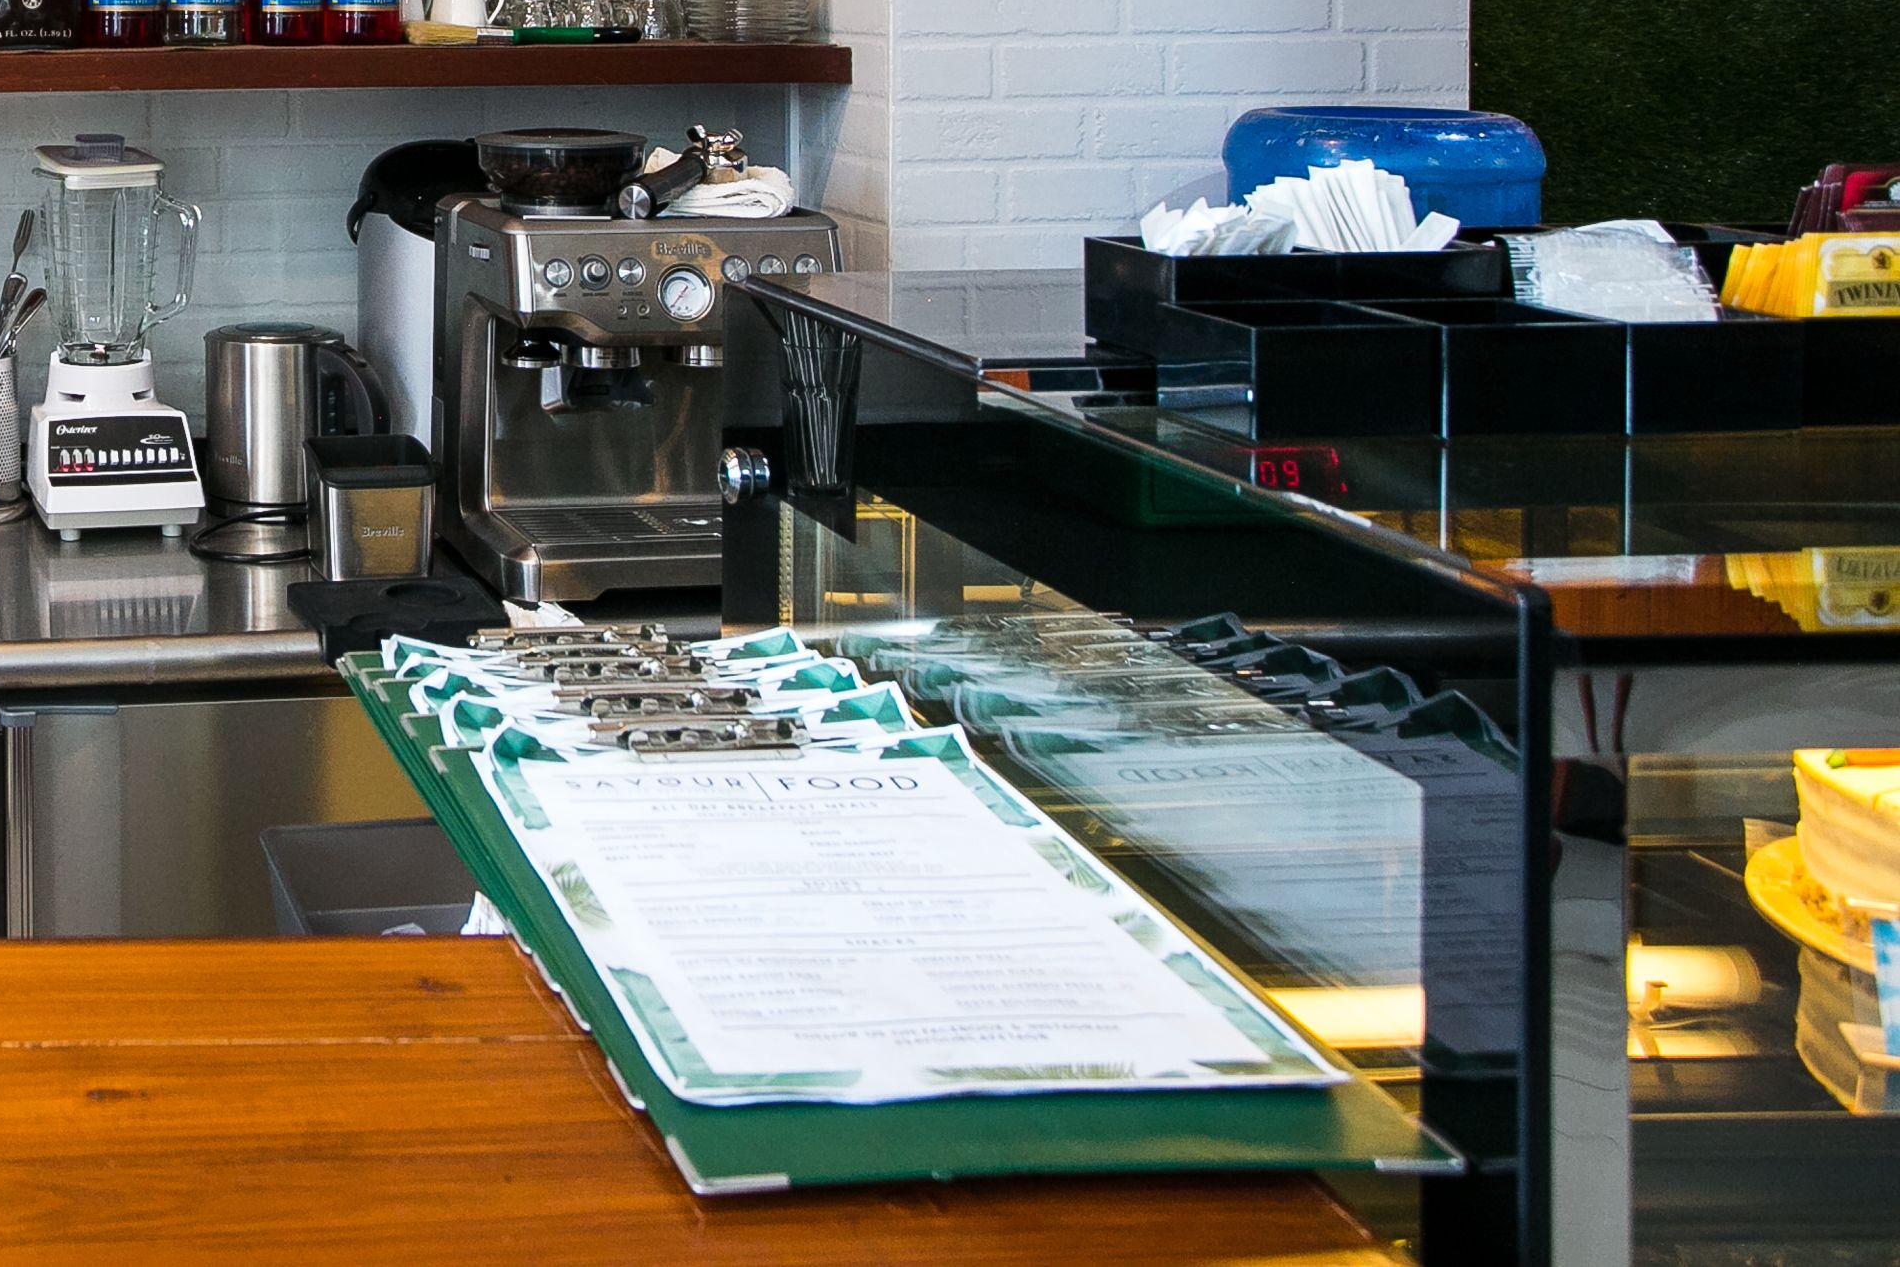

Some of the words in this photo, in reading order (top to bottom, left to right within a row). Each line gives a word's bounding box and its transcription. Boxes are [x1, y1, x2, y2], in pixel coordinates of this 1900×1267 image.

[5, 29, 18, 38] FL.
[20, 29, 36, 38] OZ.
[39, 28, 61, 39] (1.89
[1834, 283, 1900, 305] TWININ
[56, 424, 99, 436] Osterizer
[361, 526, 405, 538] Breville
[565, 775, 745, 790] SAVOUR
[779, 775, 919, 791] FOOD
